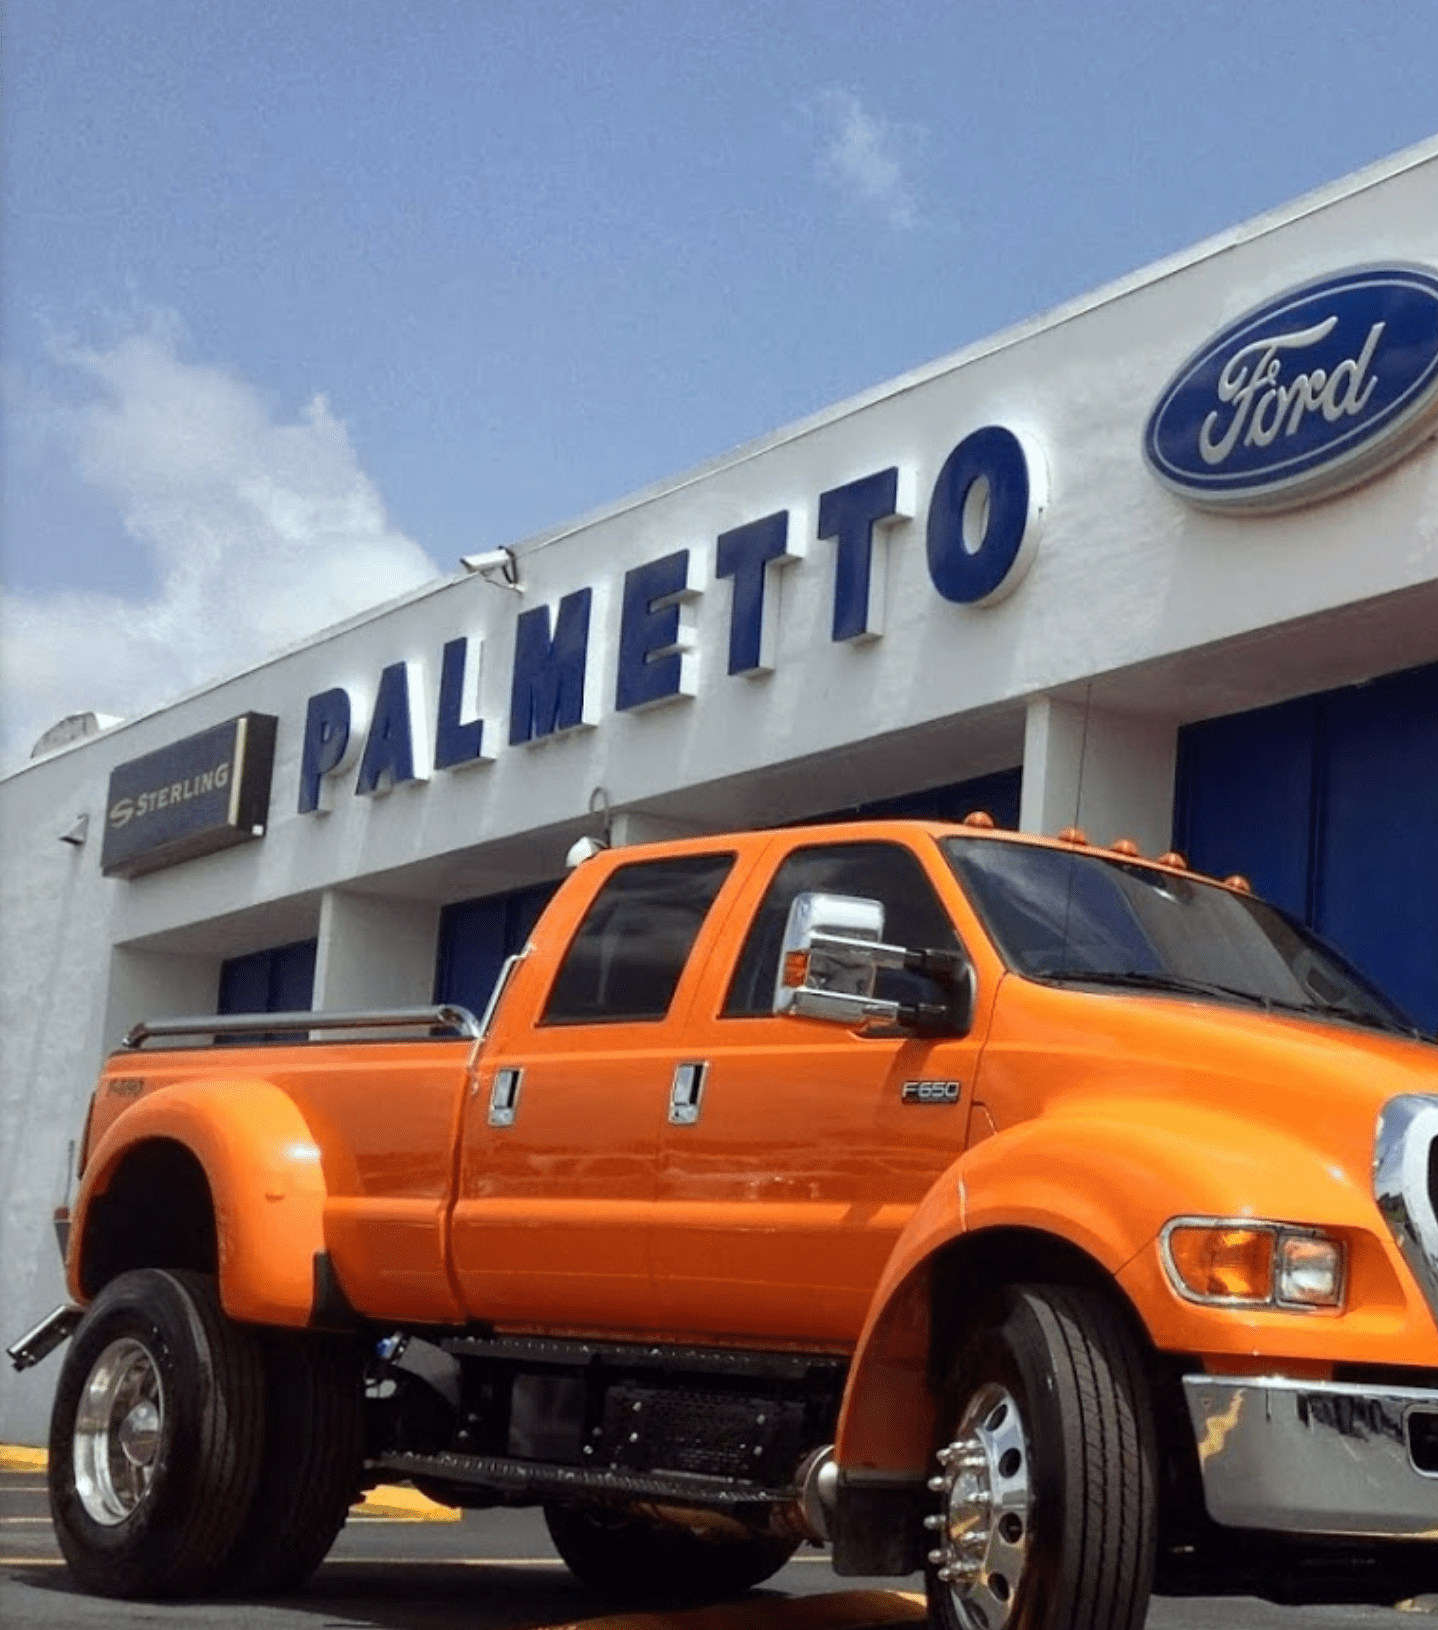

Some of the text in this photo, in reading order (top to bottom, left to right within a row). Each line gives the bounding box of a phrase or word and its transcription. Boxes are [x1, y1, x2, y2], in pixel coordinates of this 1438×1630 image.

[1200, 315, 1387, 465] Ford
[297, 424, 1030, 815] PALMETTO
[136, 763, 229, 816] STERLING
